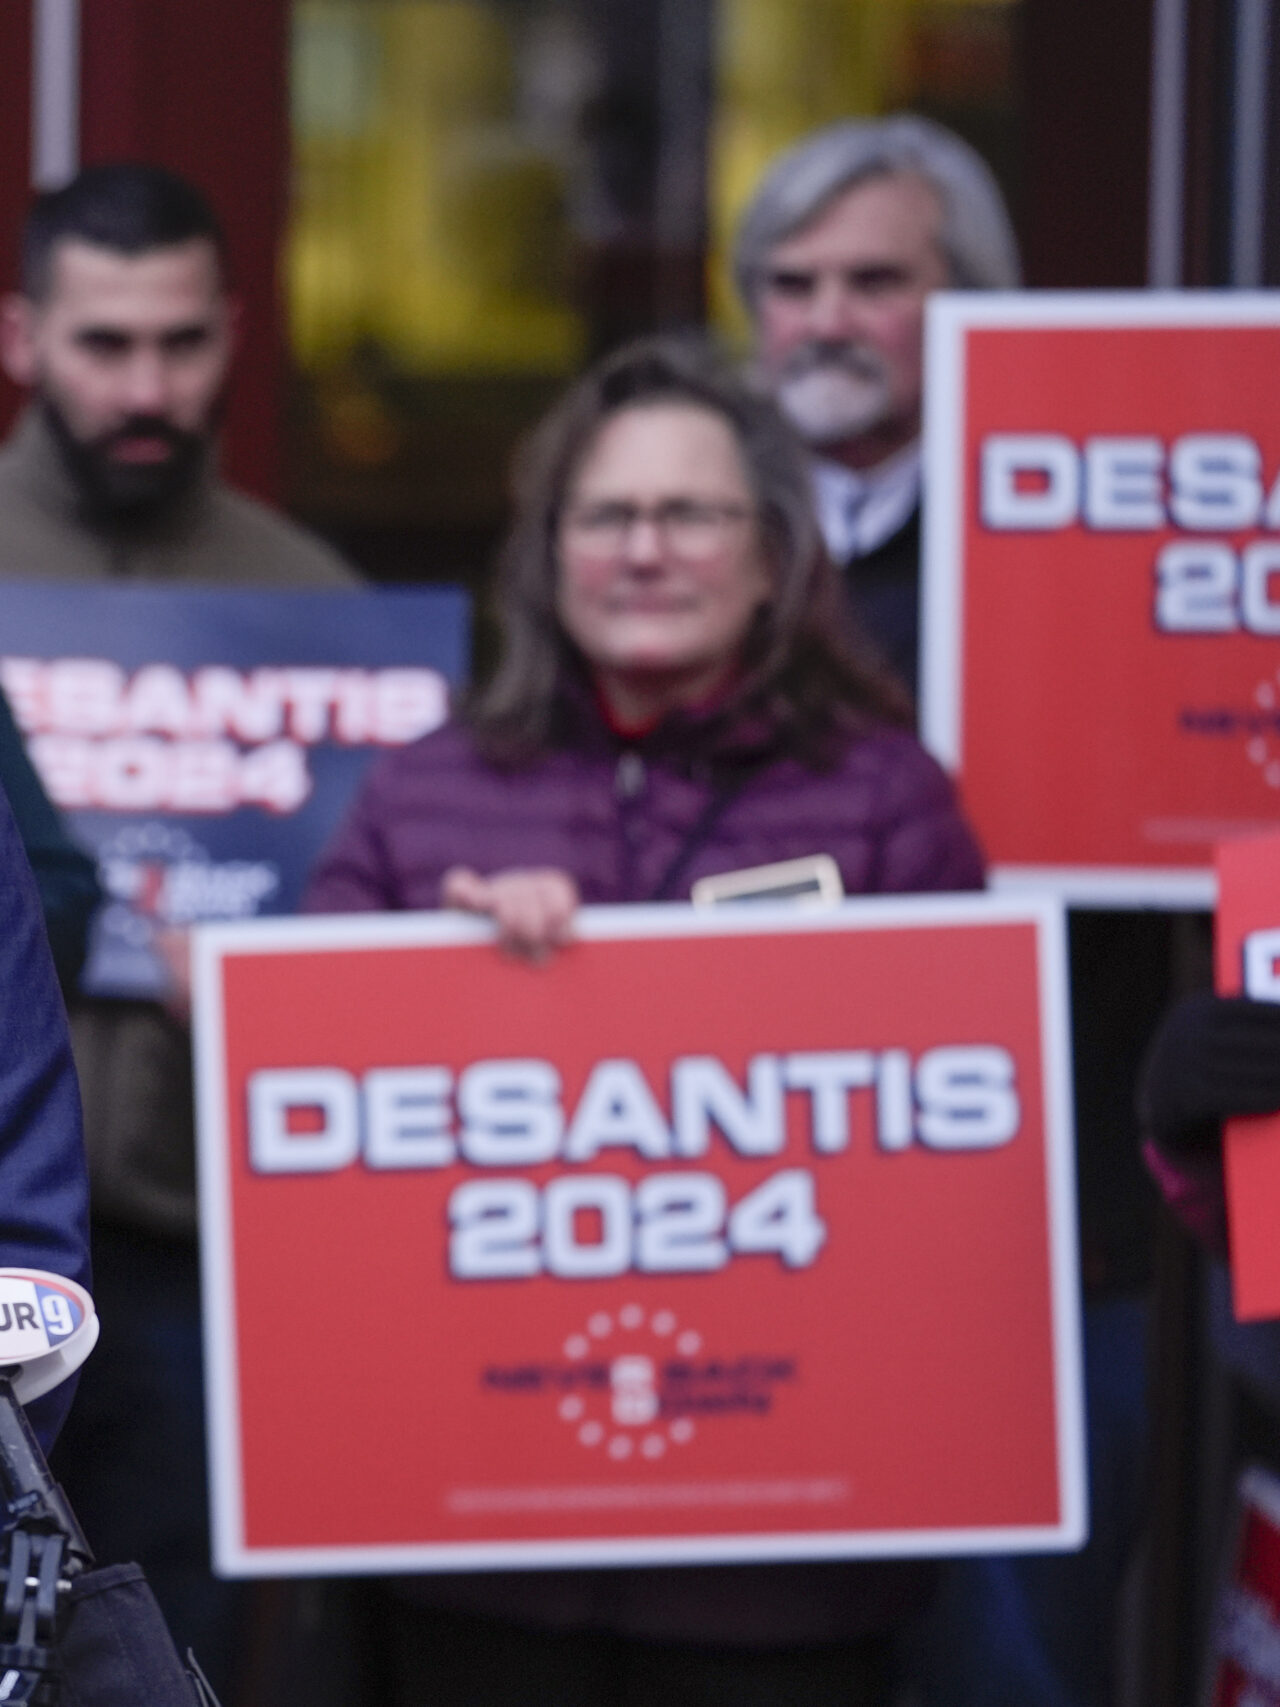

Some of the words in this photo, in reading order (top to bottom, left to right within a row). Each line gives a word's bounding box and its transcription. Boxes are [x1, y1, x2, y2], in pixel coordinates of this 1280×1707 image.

[980, 432, 1280, 533] DES
[246, 1043, 1022, 1174] DESANTIS
[446, 1167, 828, 1280] 2024
[42, 1294, 74, 1336] 9
